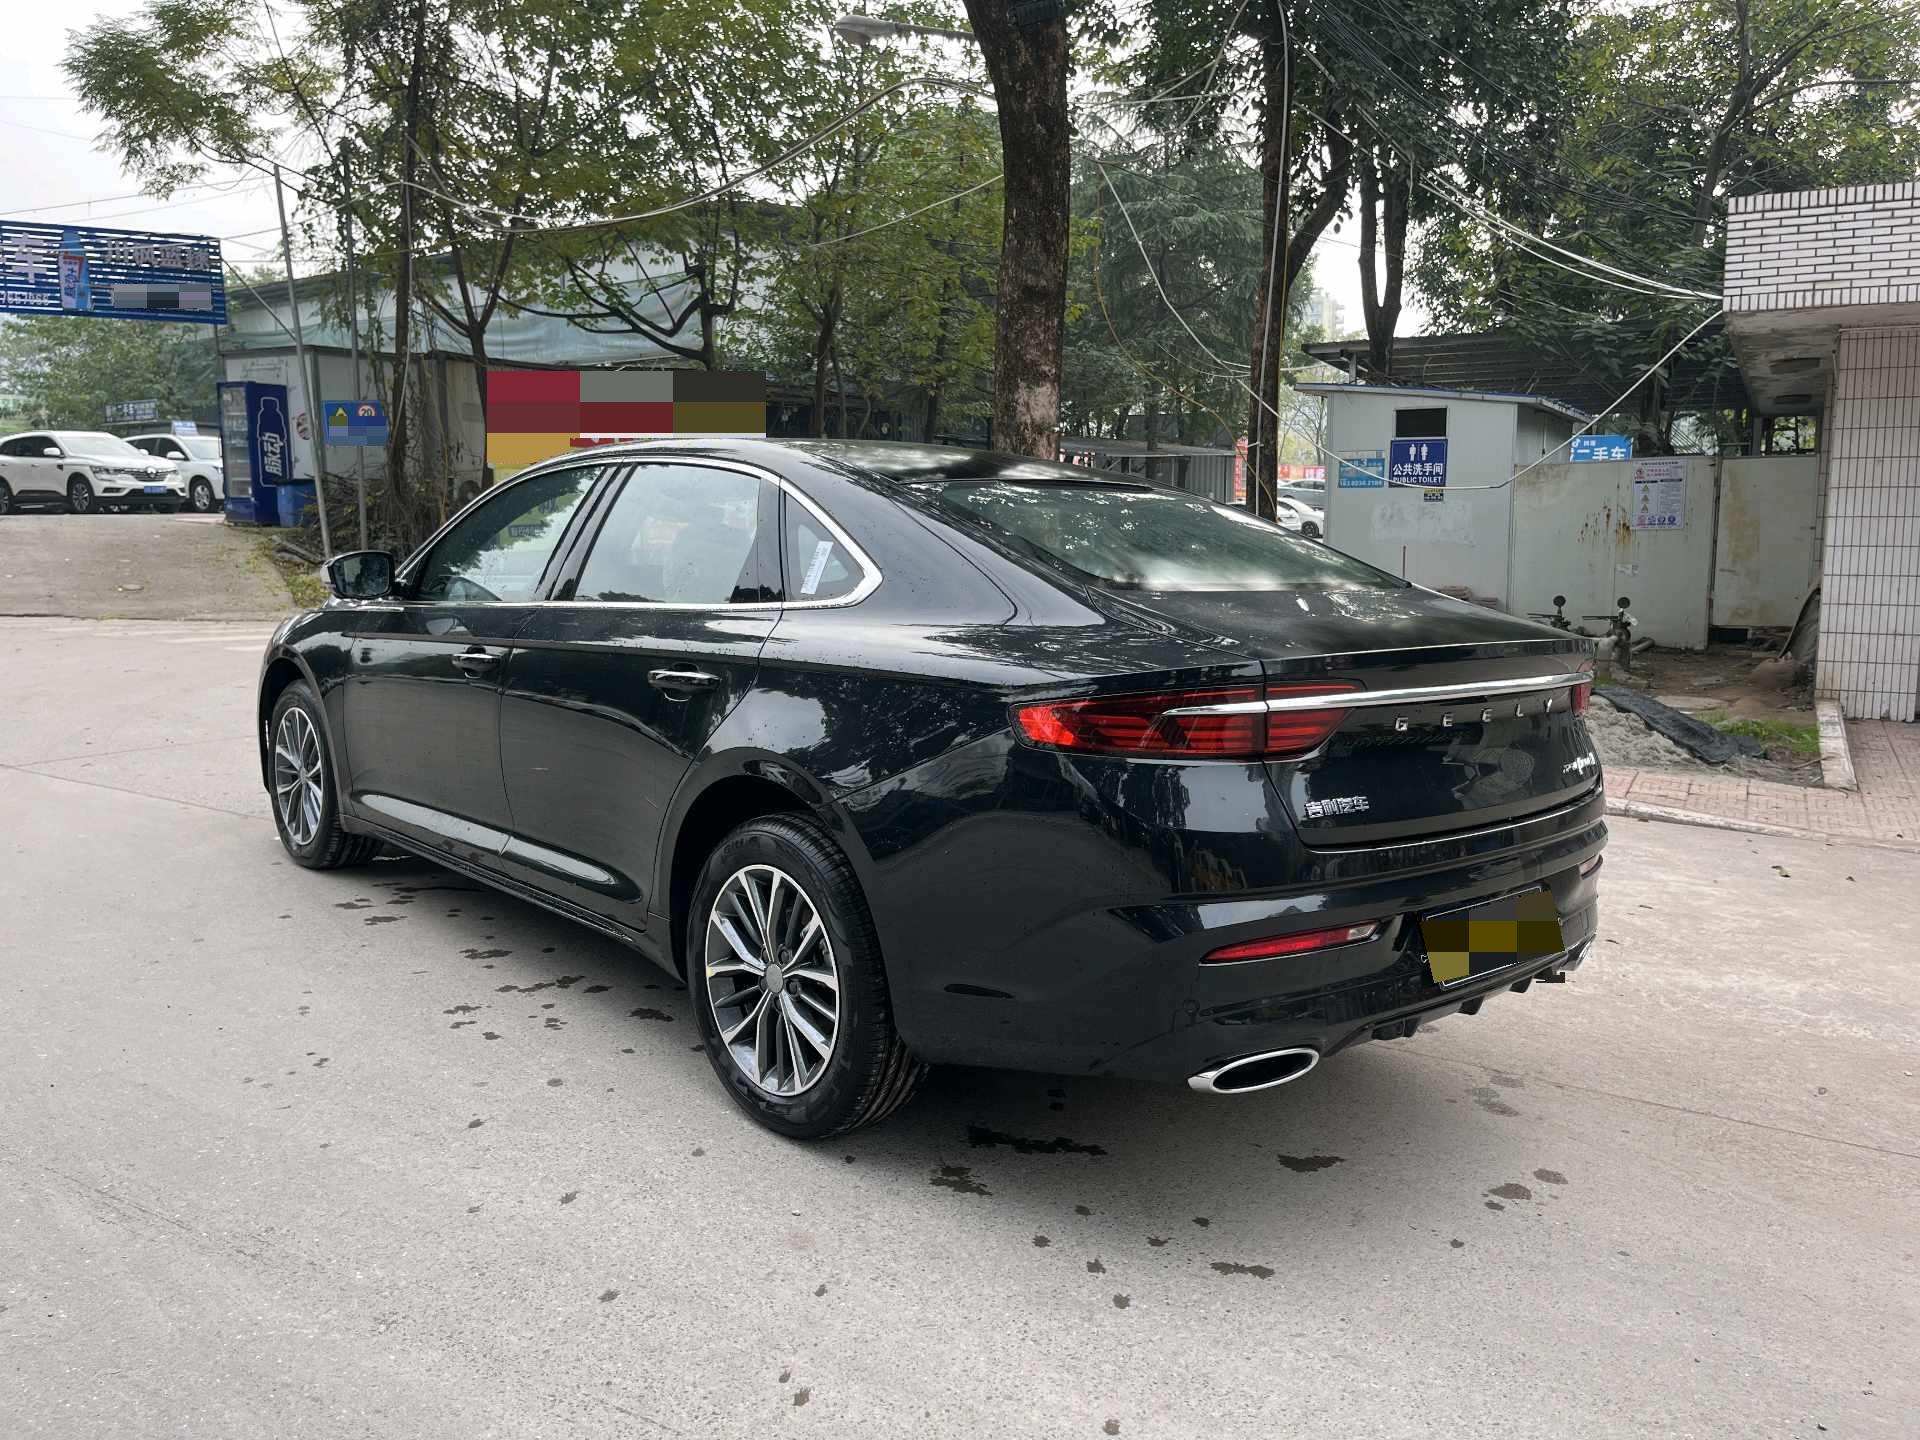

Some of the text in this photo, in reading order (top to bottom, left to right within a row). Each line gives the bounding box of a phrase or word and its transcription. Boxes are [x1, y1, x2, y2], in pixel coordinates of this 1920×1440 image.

[361, 407, 373, 416] 20
[262, 431, 285, 477] 脉动
[1570, 446, 1627, 462] 二手车
[1392, 463, 1443, 476] 公共洗手间
[1392, 476, 1417, 484] PUBLIC
[1395, 698, 1553, 732] GEELY
